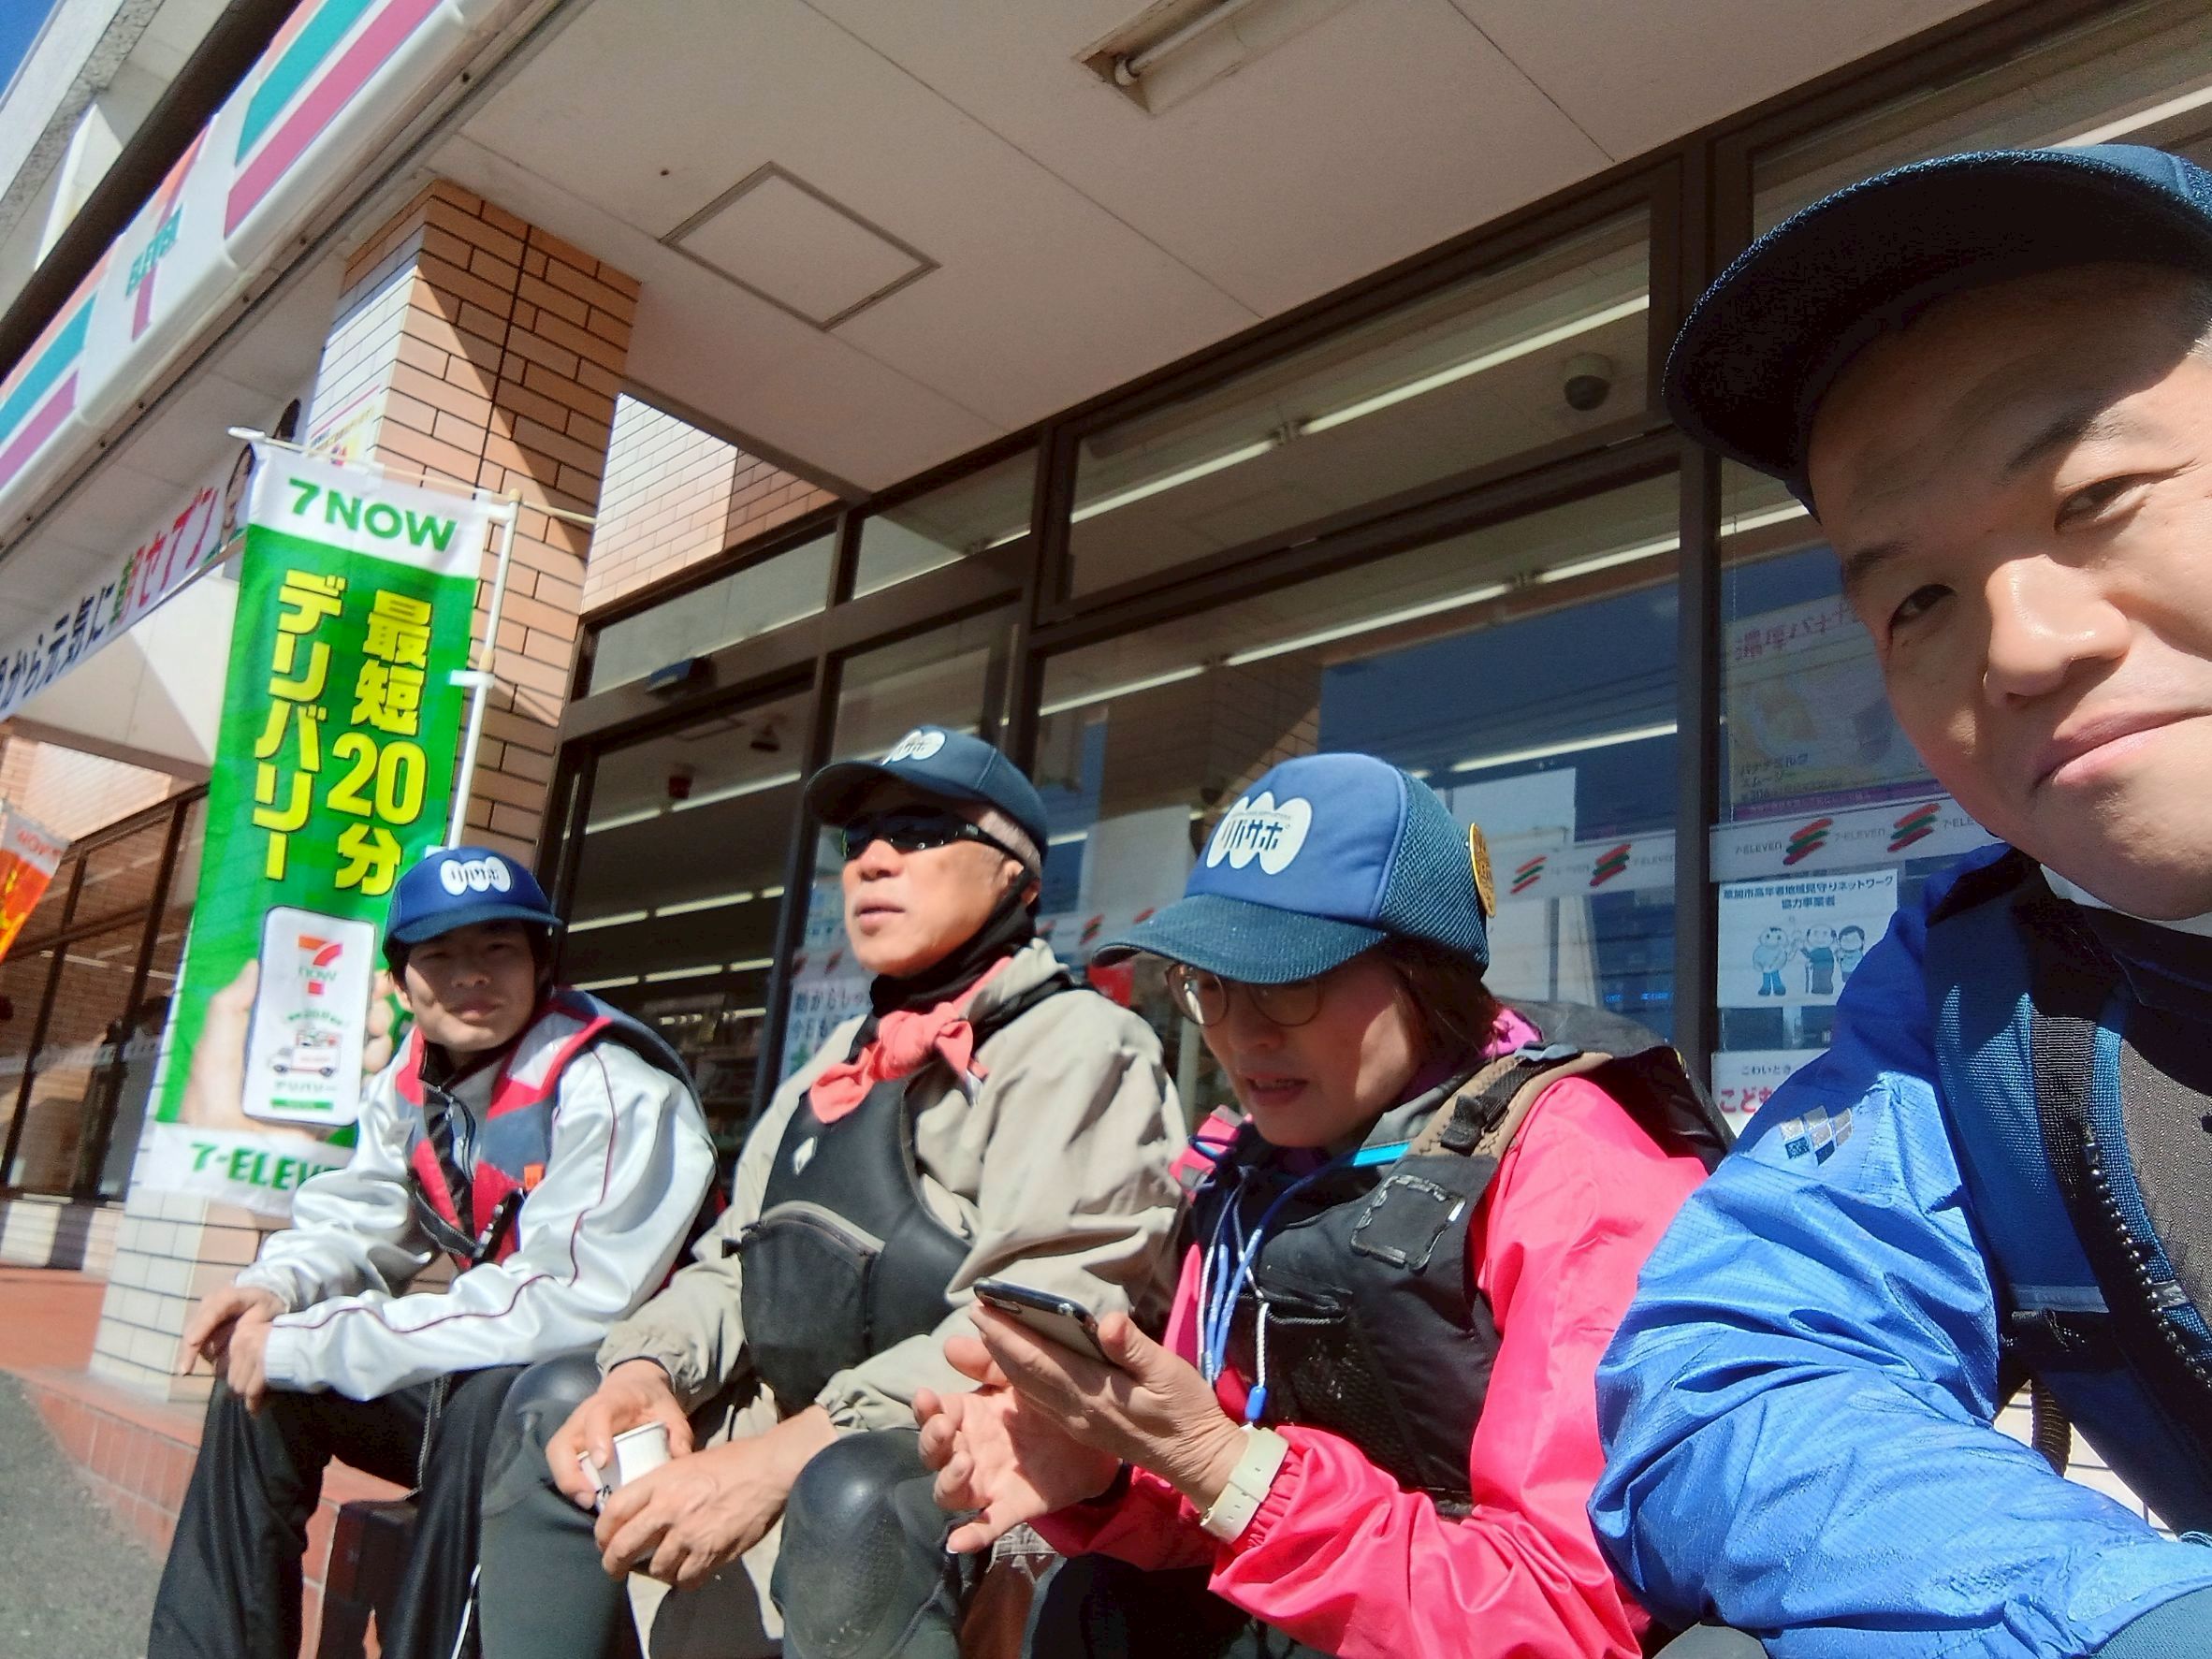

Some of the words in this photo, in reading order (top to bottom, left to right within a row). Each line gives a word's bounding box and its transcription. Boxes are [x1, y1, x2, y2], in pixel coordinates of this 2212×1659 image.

[253, 569, 346, 880] デリバリー
[326, 589, 432, 895] 最短20分
